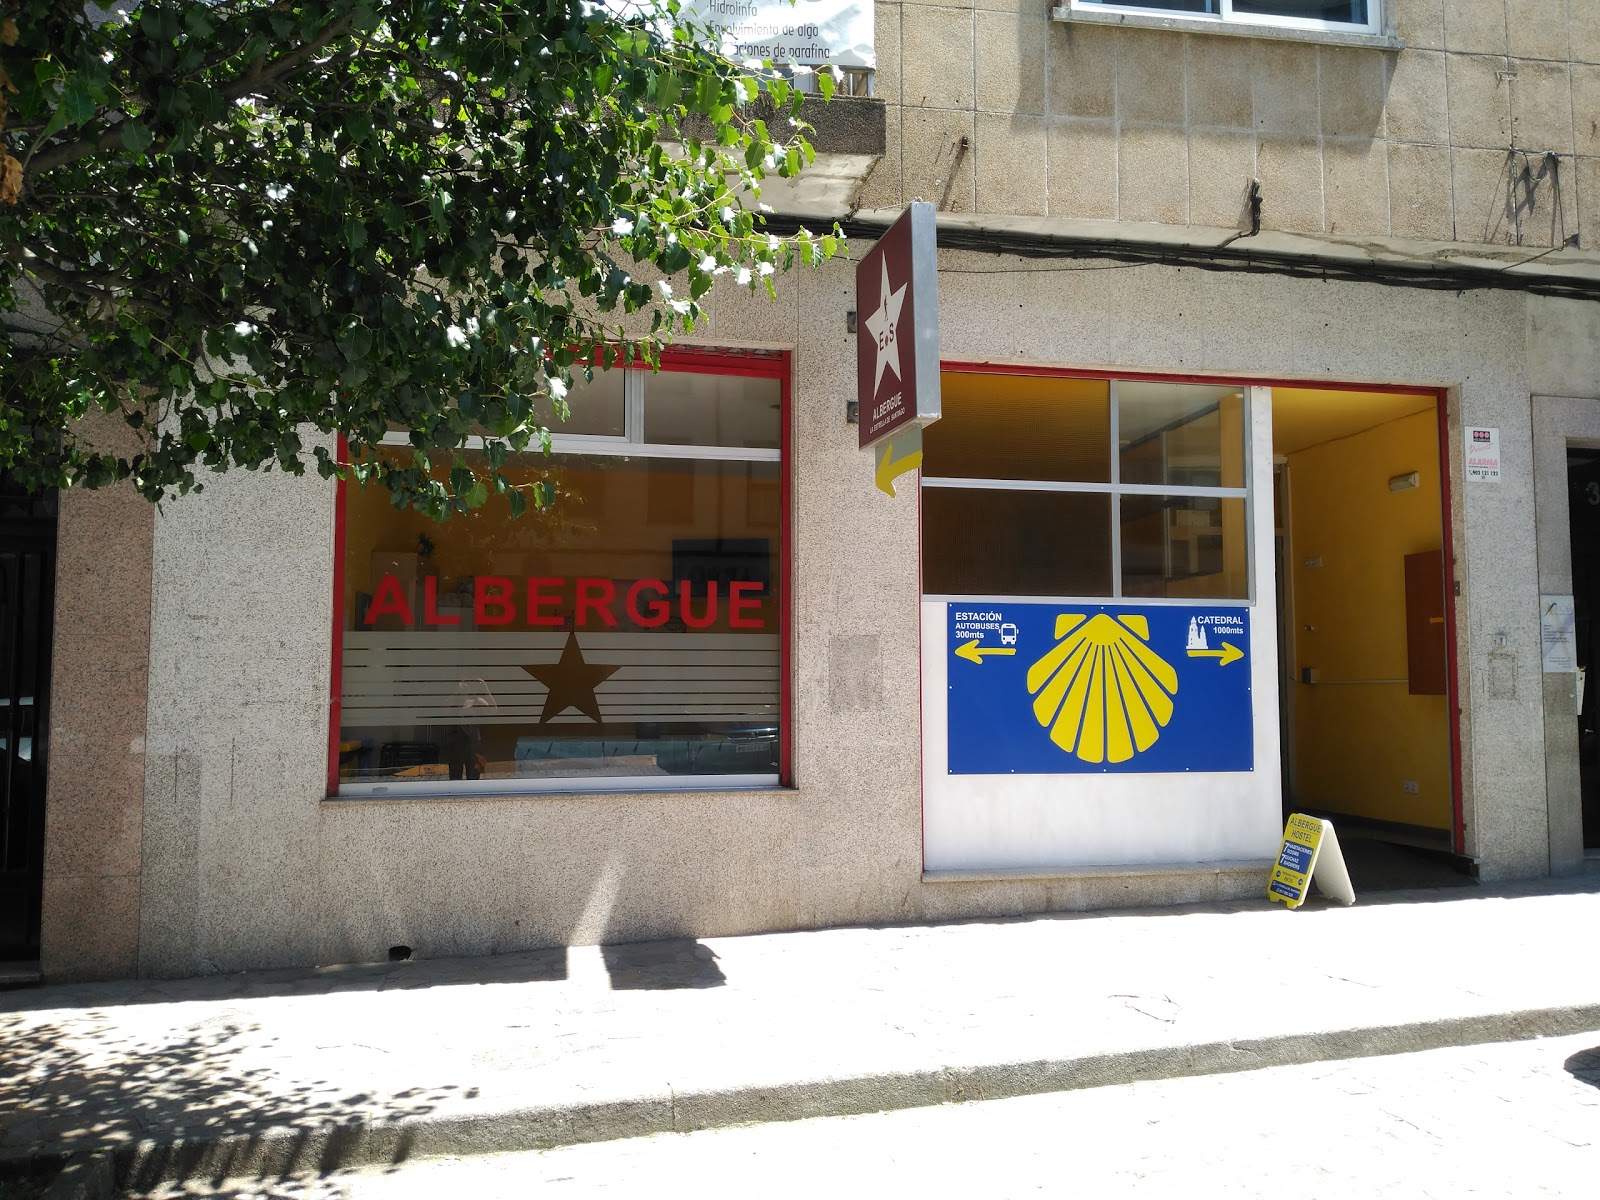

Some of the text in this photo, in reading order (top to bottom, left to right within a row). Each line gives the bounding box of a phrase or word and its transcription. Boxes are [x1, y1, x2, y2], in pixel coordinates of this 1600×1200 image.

[709, 0, 757, 16] Hidrolinfa
[783, 24, 794, 36] de
[797, 23, 818, 39] alga
[773, 42, 785, 58] de
[789, 43, 830, 58] parafina
[872, 391, 902, 421] ALBERGUE
[1468, 458, 1498, 466] ALARMA
[364, 575, 766, 629] ALBERGUE
[955, 611, 1002, 621] ESTACIÓN
[1197, 616, 1244, 625] CATEDRAL
[955, 622, 1000, 630] AUTOBUSES
[1213, 626, 1244, 635] 1000mts
[955, 631, 985, 639] 300mts
[1289, 817, 1321, 834] ALBERGUE
[1291, 829, 1312, 844] HOSTEL
